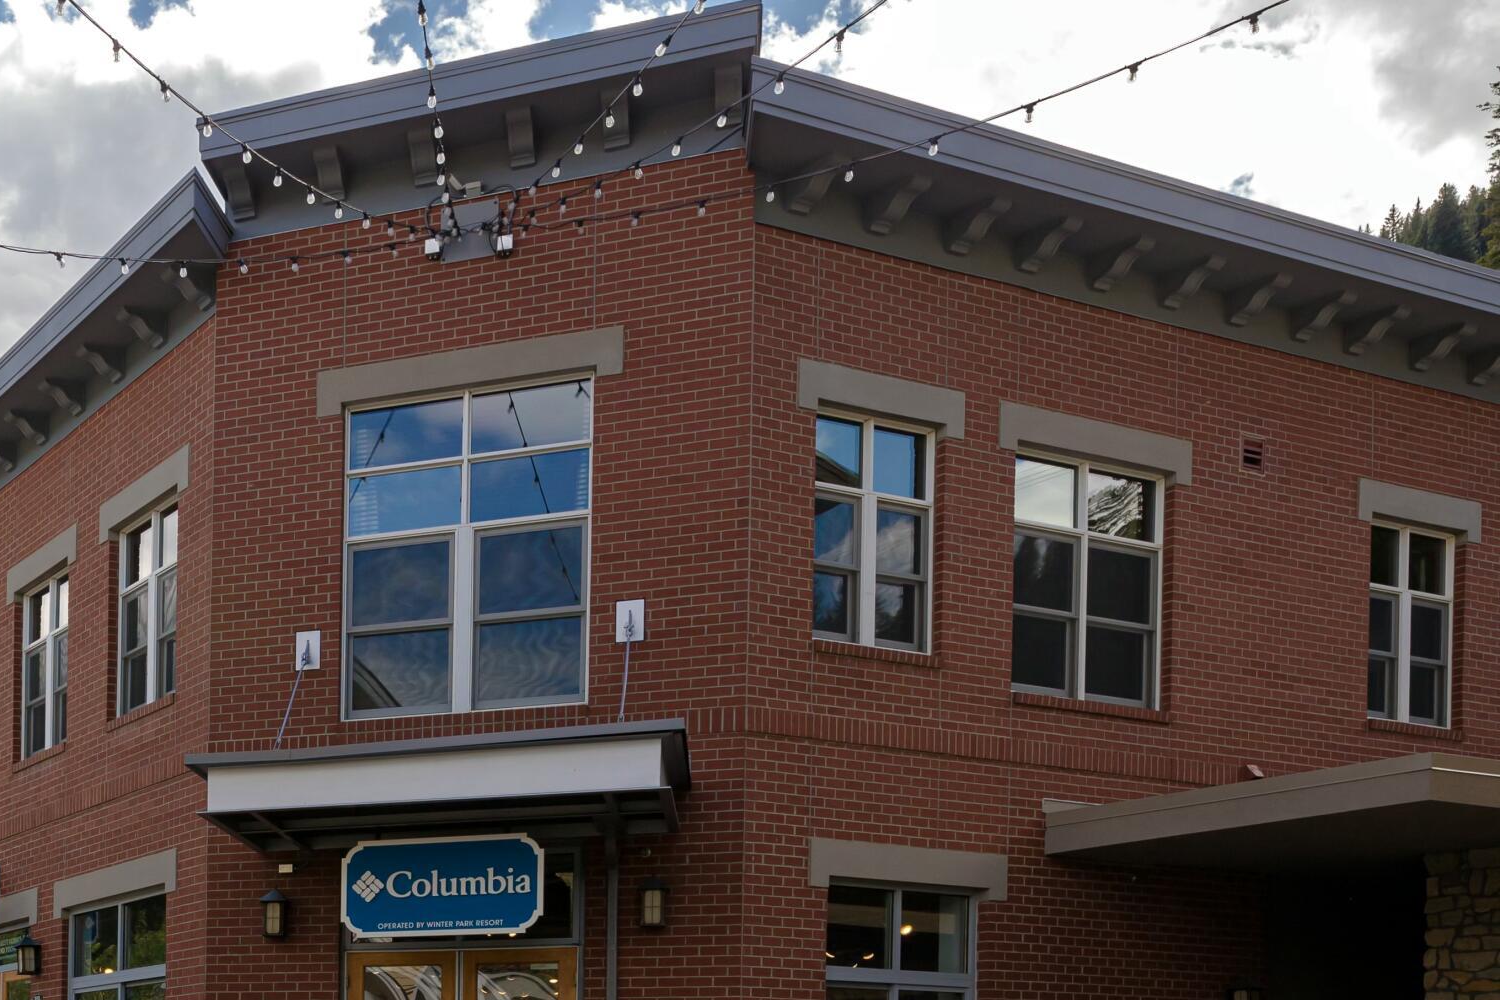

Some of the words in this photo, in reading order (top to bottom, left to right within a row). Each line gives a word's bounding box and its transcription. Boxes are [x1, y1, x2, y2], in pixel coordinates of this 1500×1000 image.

[386, 867, 531, 898] Columbia
[377, 922, 414, 930] OPERATED
[416, 921, 424, 929] BY
[426, 920, 453, 928] WINTER
[456, 920, 473, 928] PARK
[475, 919, 504, 927] RESORT
